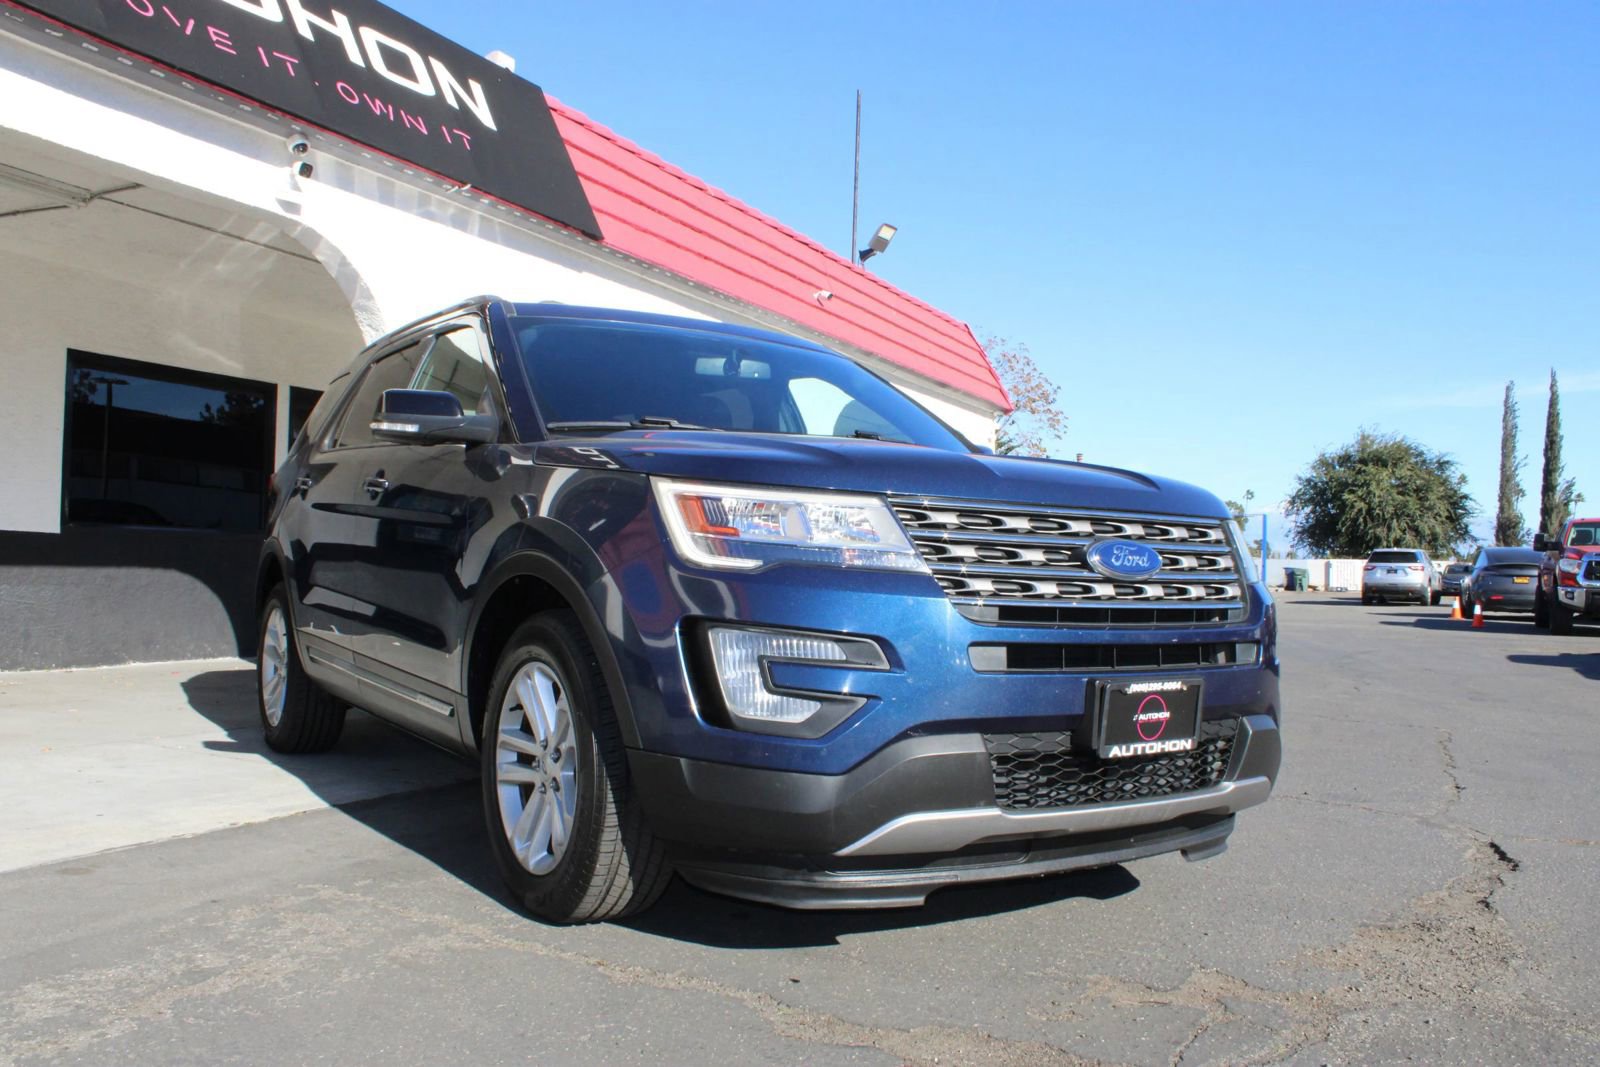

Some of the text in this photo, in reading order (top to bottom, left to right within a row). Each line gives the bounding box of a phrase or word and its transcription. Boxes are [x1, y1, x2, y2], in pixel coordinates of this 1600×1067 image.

[220, 0, 497, 131] HON
[336, 81, 428, 135] OWN
[441, 125, 471, 150] IT
[1111, 544, 1151, 567] Ford
[1138, 711, 1170, 721] AUTOHON
[1109, 738, 1192, 758] AUTOHON
